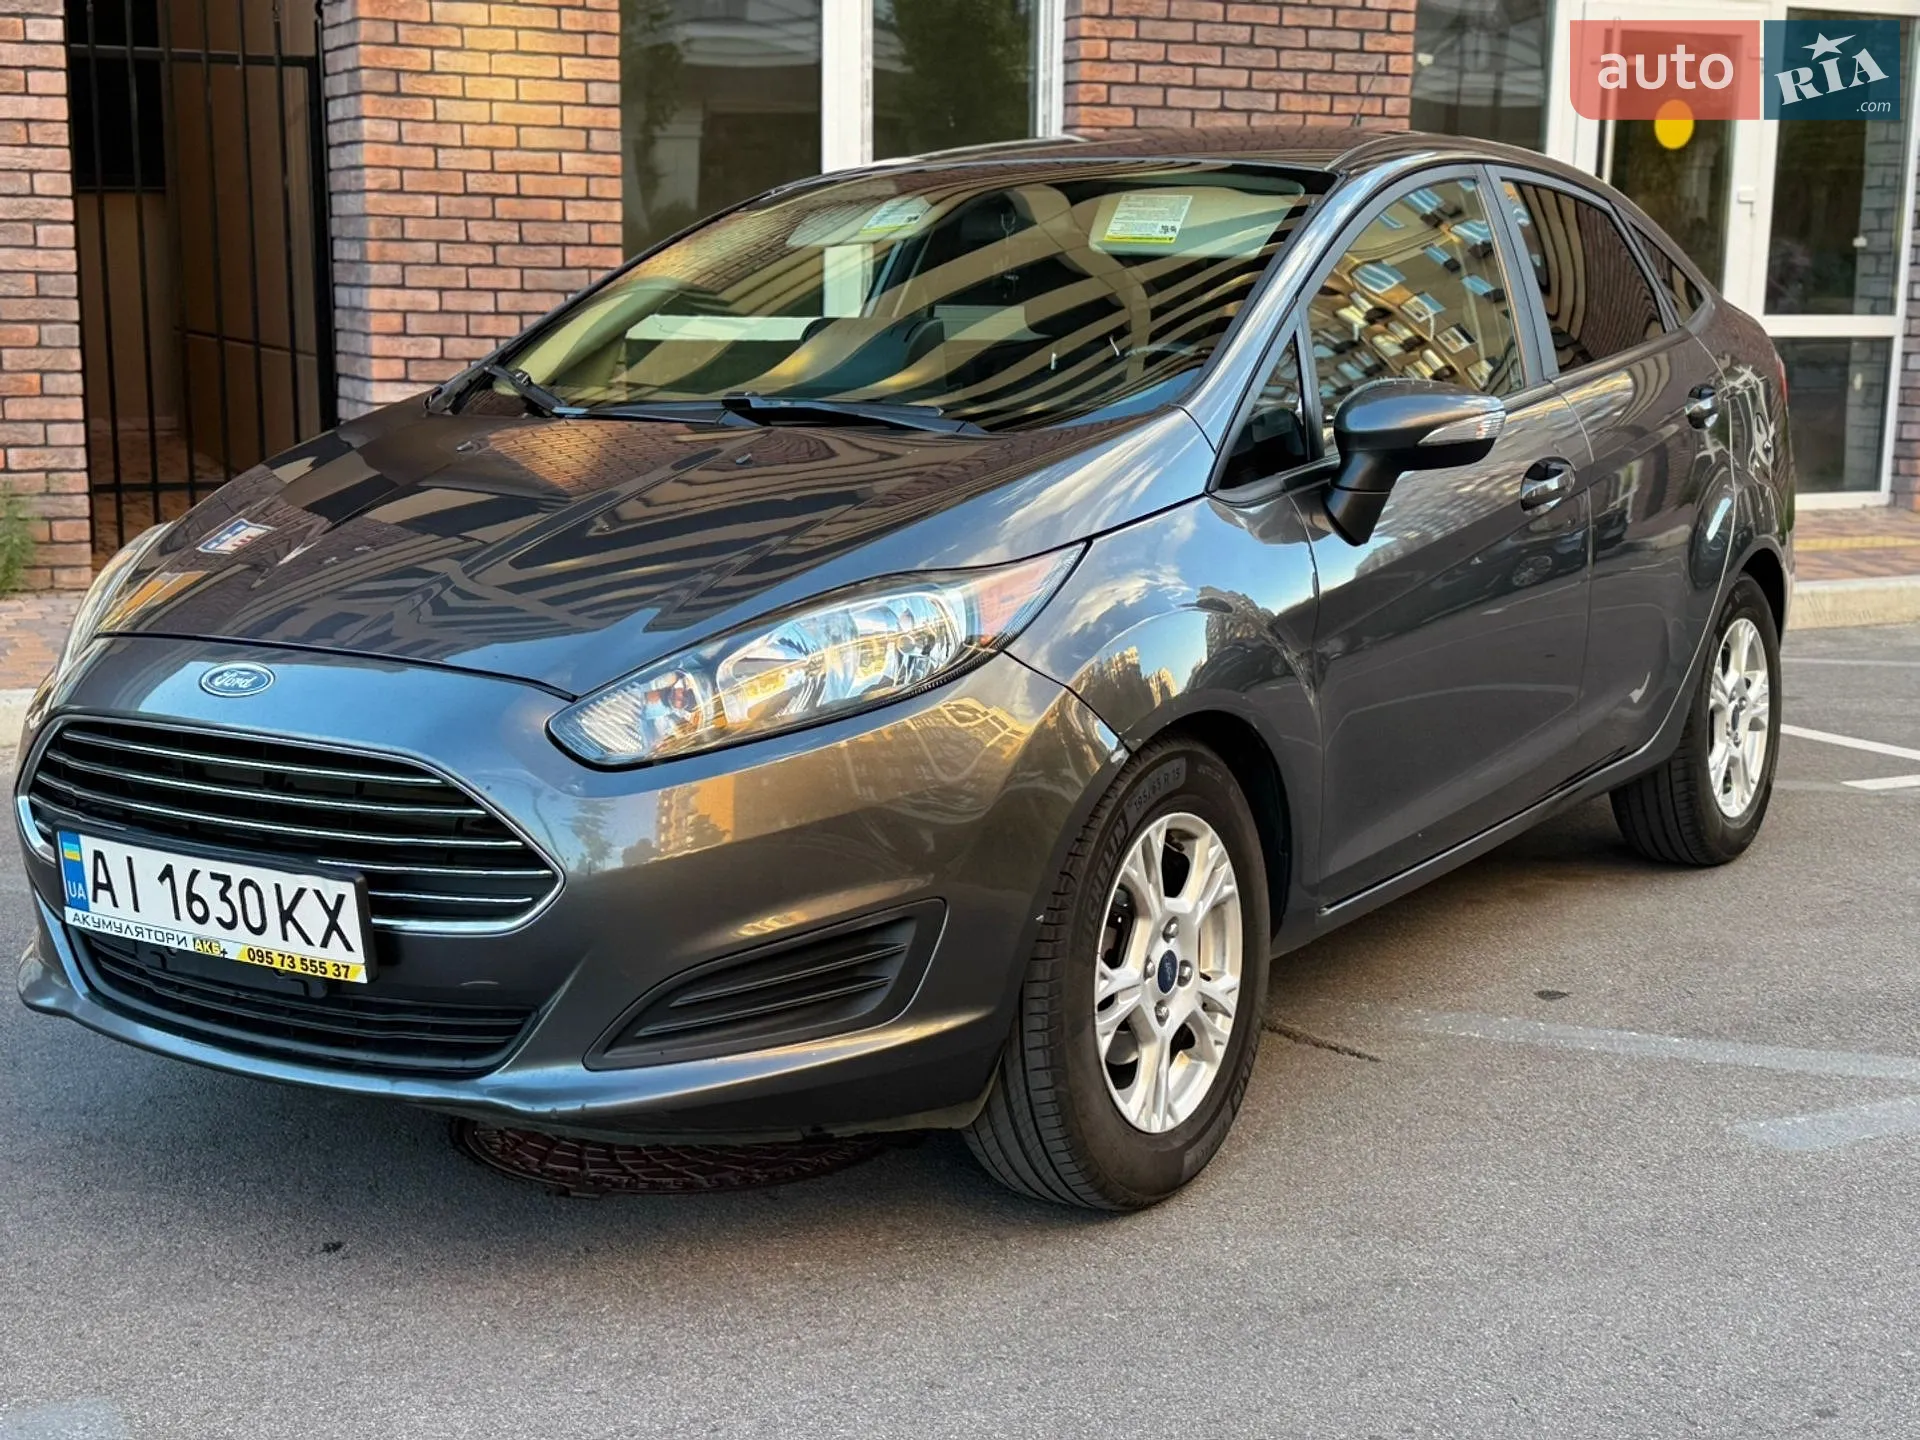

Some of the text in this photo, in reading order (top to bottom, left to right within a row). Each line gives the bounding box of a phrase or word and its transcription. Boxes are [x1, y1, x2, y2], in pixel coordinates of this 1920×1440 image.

[213, 670, 257, 688] Ford
[69, 881, 86, 899] UA
[73, 912, 188, 947] АКУМУЛЯТОРИ
[247, 947, 274, 965] 095
[278, 953, 296, 970] 73
[300, 957, 328, 976] 555
[332, 963, 350, 979] 37
